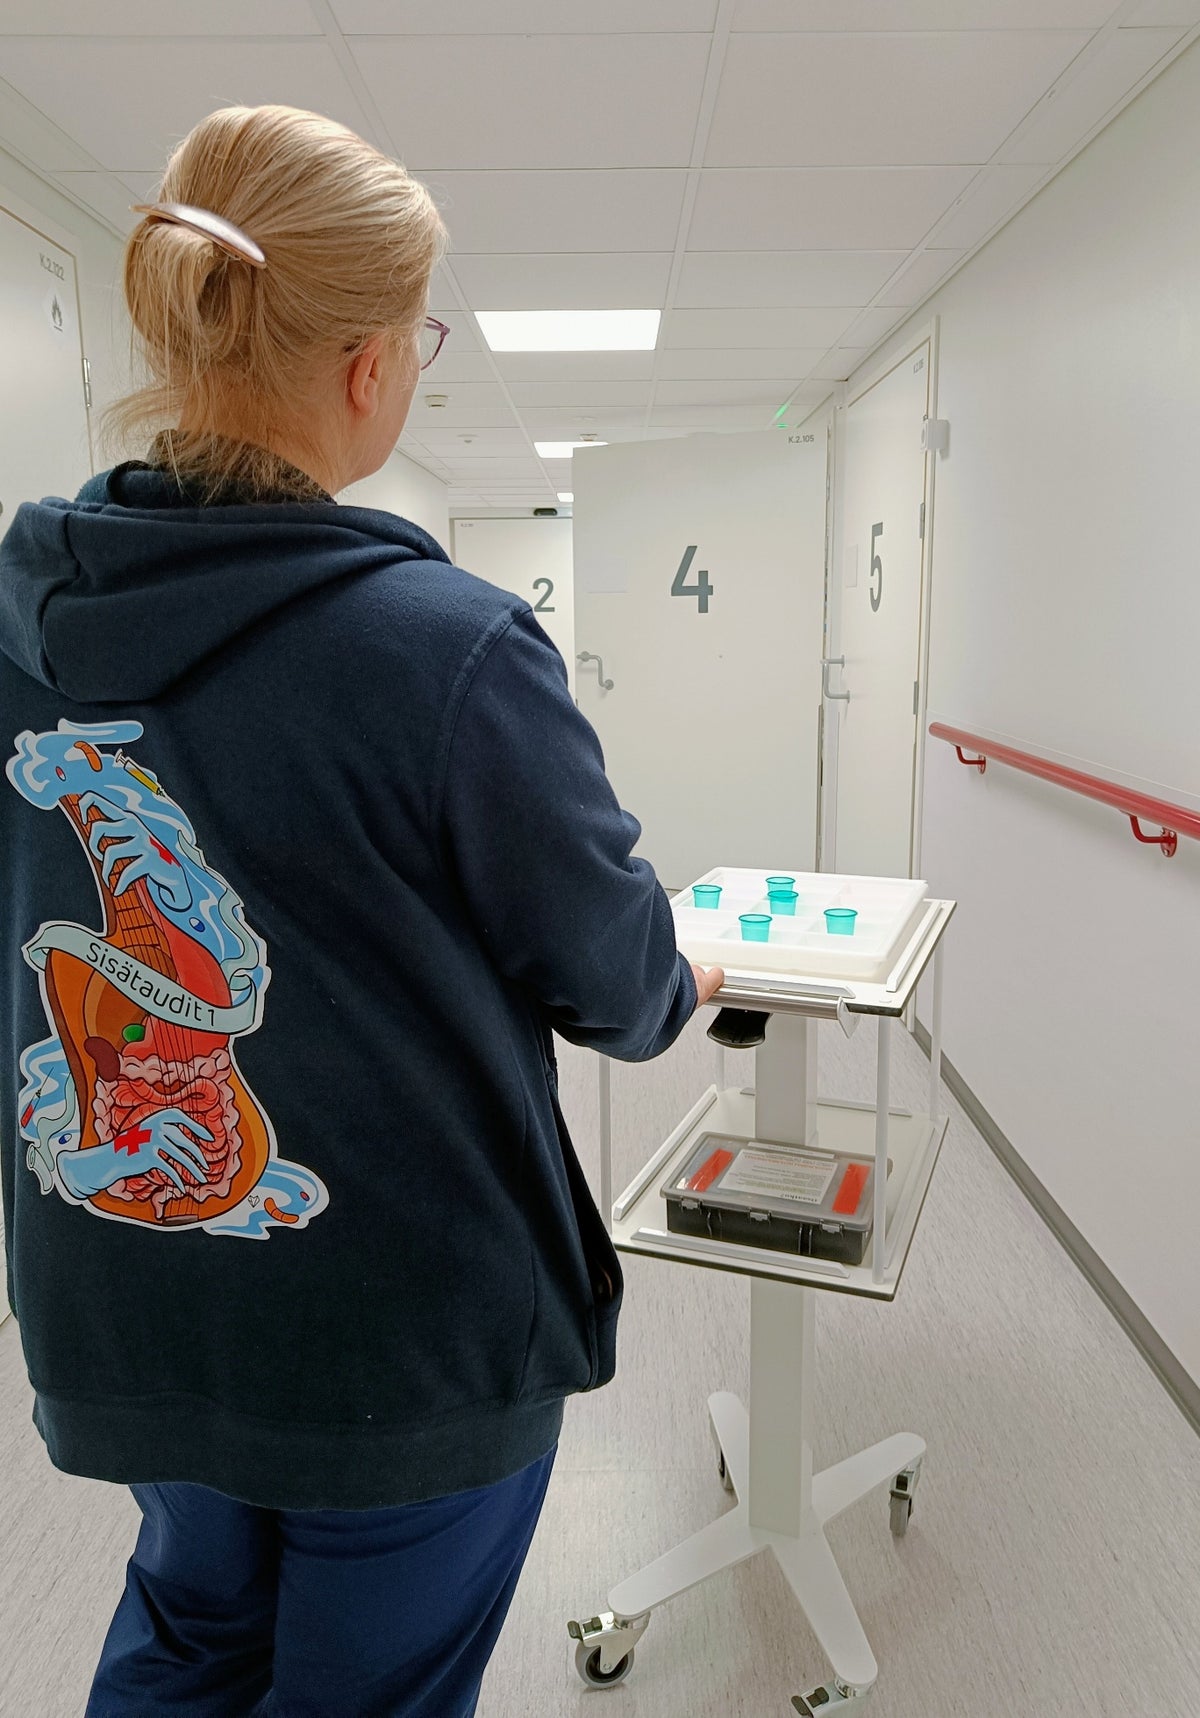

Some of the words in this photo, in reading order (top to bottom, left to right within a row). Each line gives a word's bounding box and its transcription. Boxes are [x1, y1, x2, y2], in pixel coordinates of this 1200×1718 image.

[788, 434, 815, 445] K.2.105
[670, 545, 714, 614] 4
[869, 521, 884, 613] 5
[532, 577, 556, 613] 2
